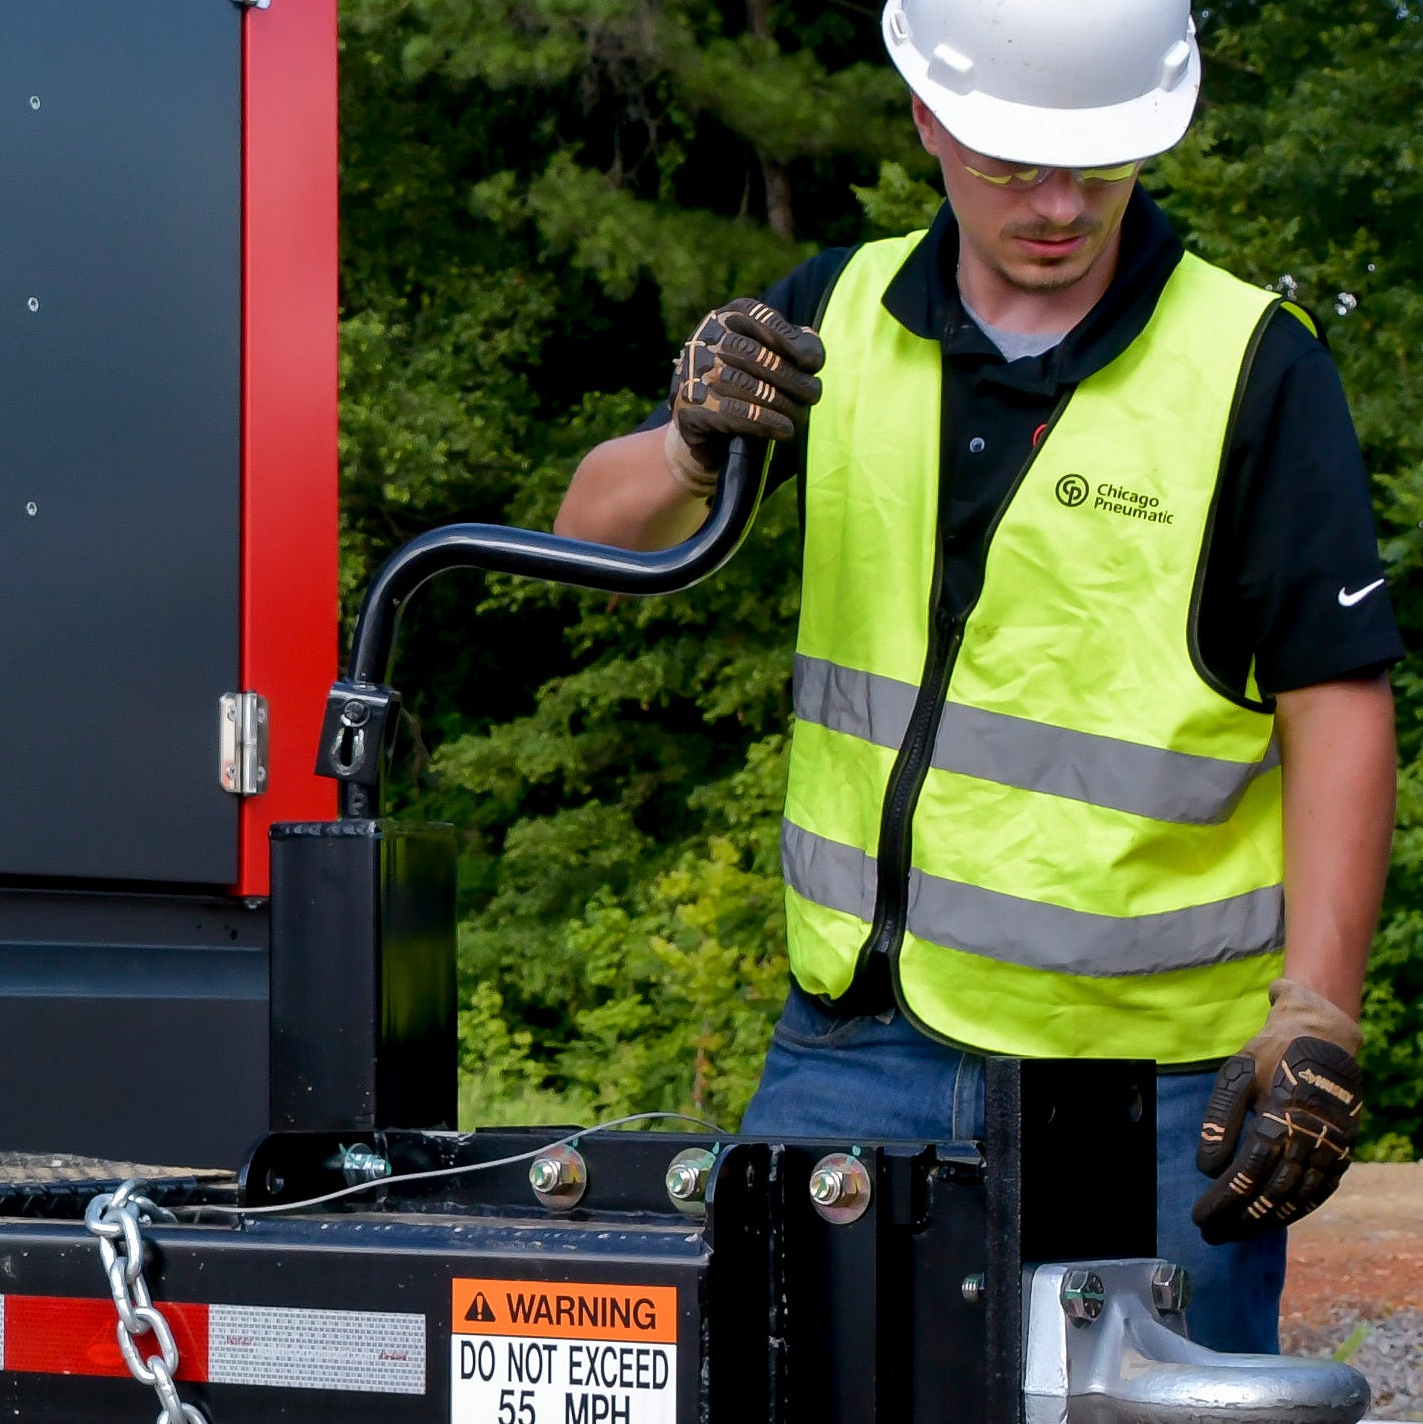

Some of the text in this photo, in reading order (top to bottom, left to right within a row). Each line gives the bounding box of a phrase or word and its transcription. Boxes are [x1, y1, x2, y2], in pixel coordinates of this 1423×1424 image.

[1094, 496, 1174, 525] Pneumatic
[1097, 483, 1159, 509] Chicago
[506, 1292, 657, 1330] WARNING
[460, 1340, 669, 1390] DO NOT EXCEED
